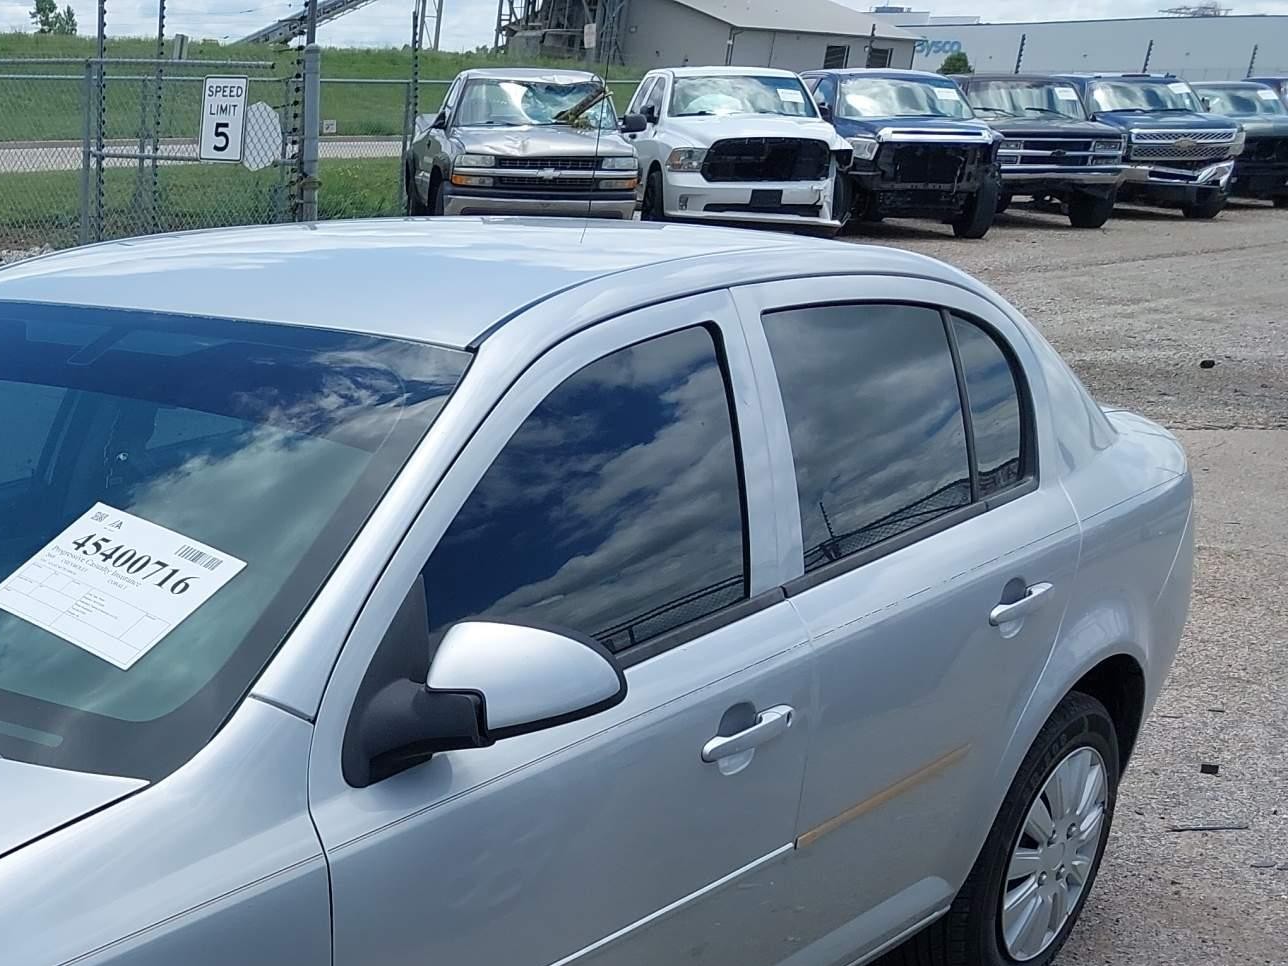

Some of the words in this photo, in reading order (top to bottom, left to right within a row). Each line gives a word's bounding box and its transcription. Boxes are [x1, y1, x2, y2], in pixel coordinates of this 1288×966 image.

[208, 85, 243, 98] SPEED
[209, 104, 238, 116] LIMIT
[213, 122, 230, 152] 5
[72, 533, 201, 595] 45400716
